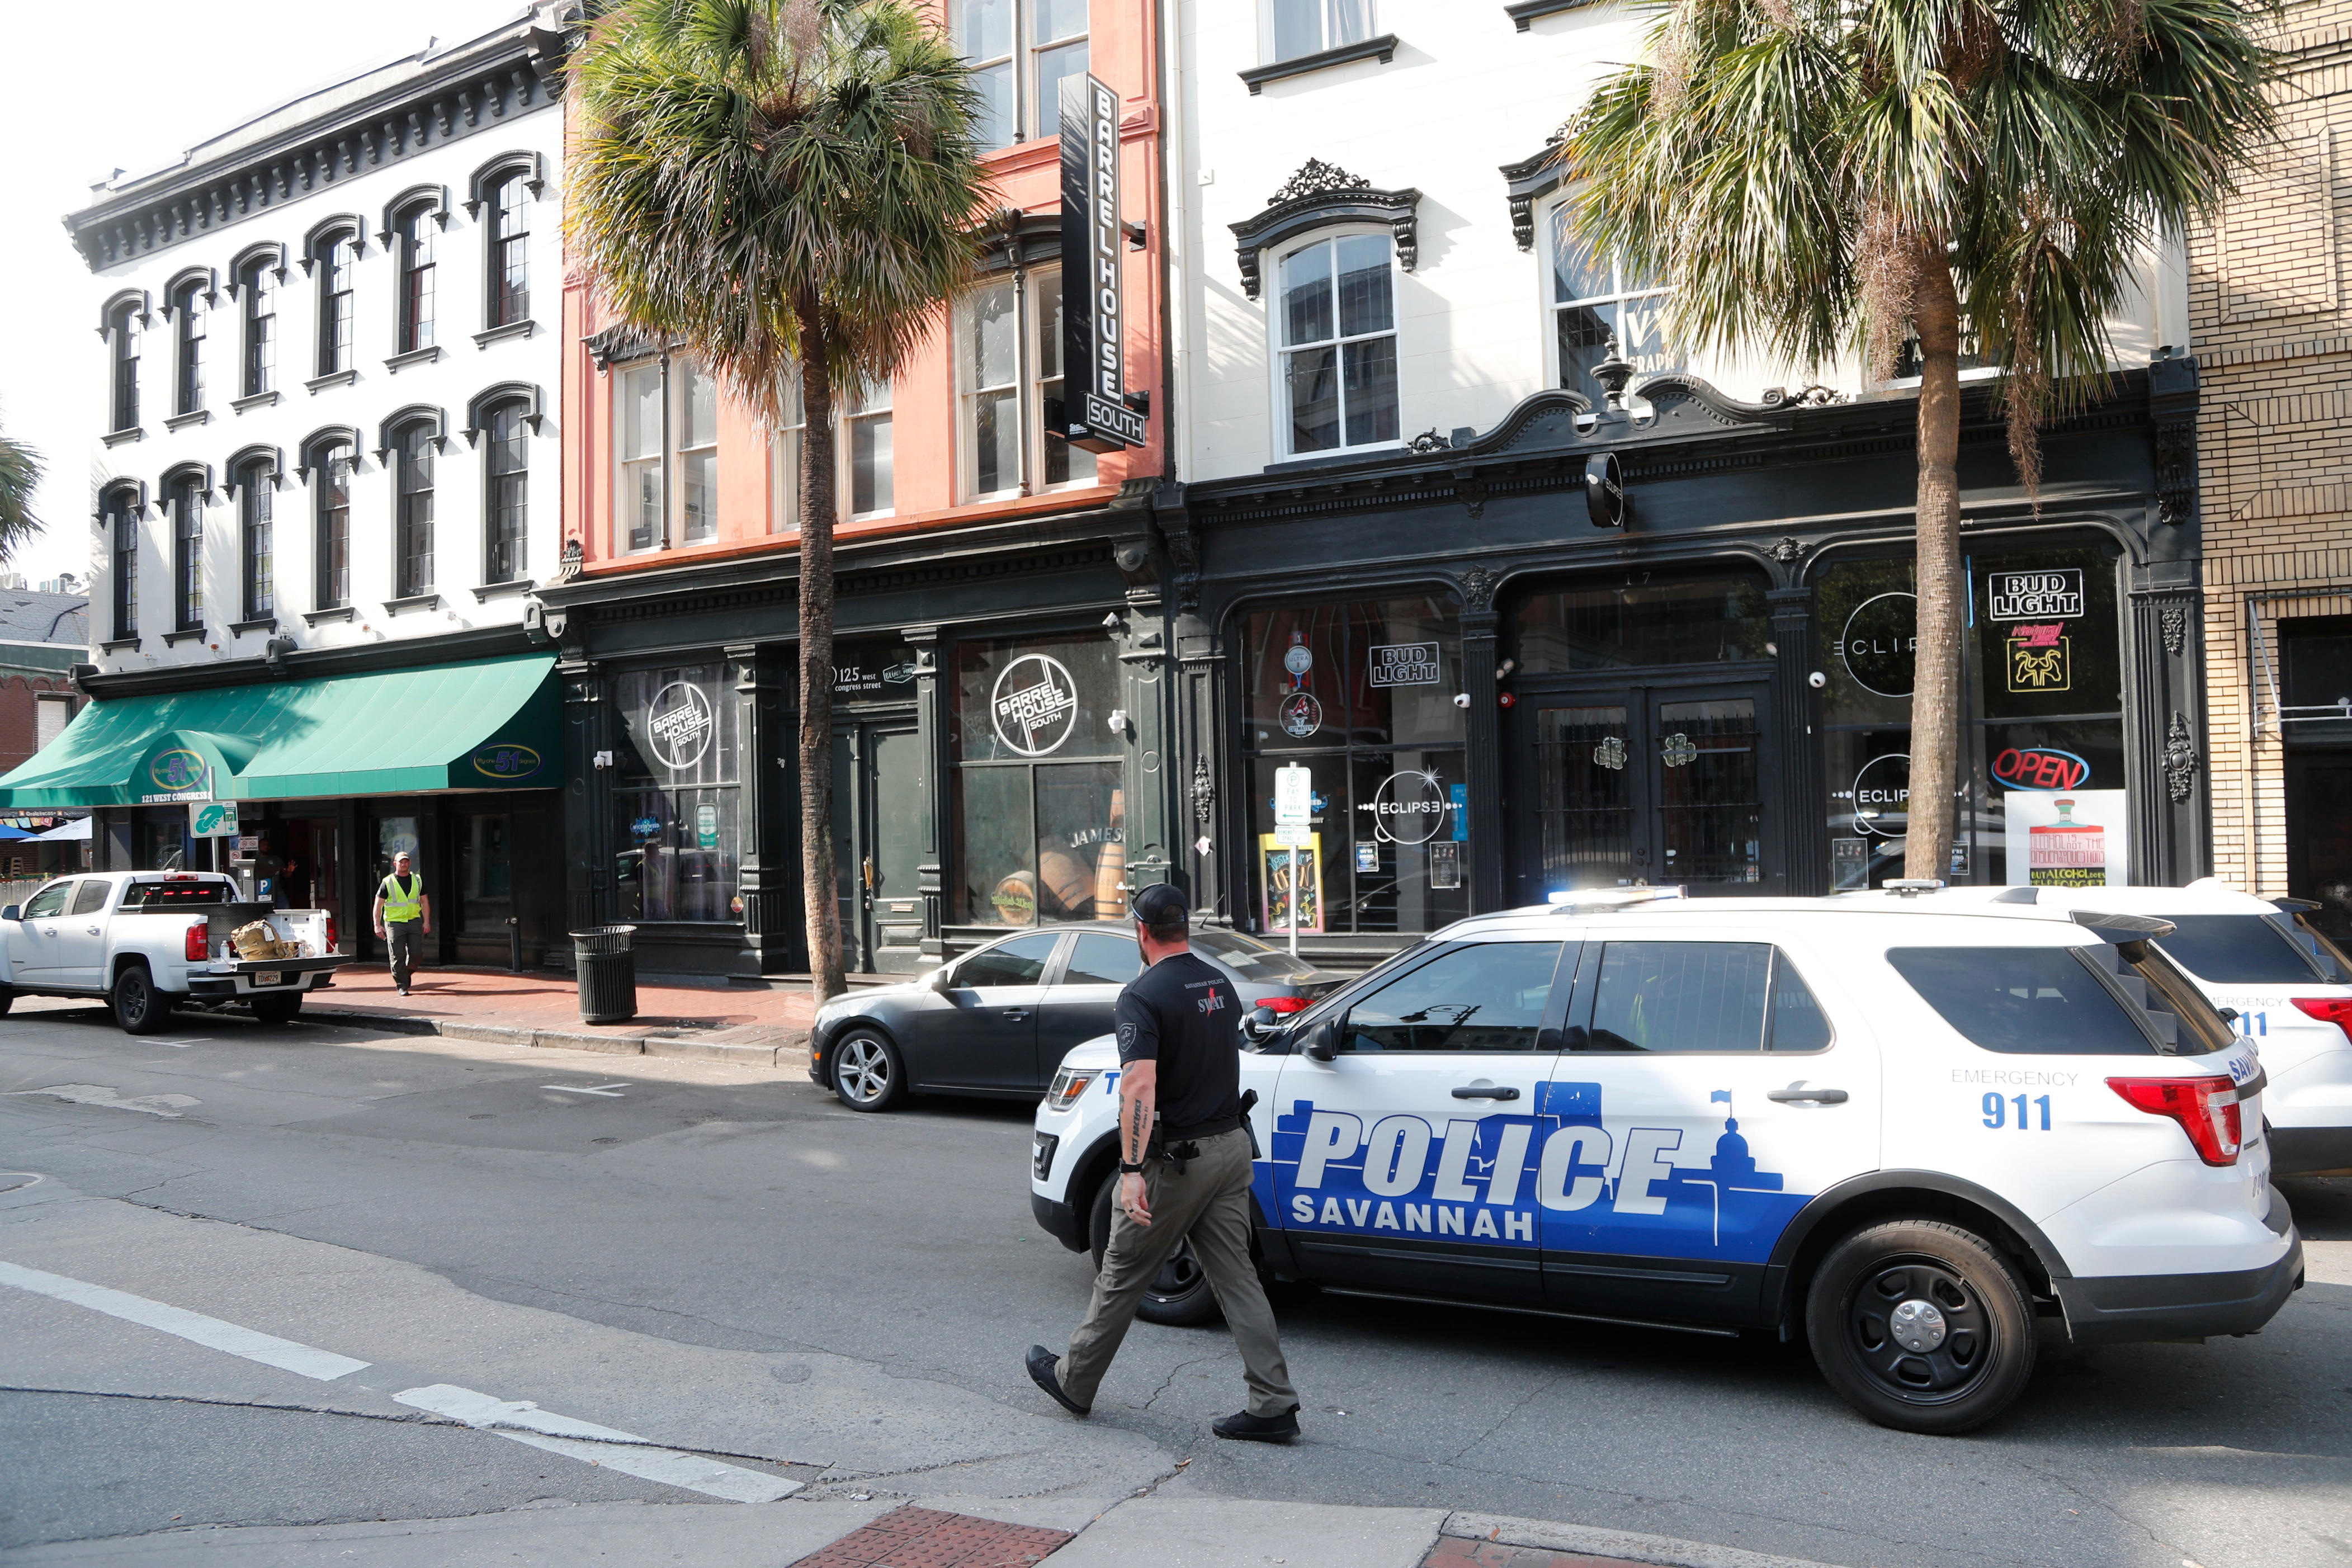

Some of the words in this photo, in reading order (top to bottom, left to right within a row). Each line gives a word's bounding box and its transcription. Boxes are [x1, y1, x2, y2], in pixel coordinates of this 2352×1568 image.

[1090, 401, 1142, 440] SOUTH
[2005, 574, 2066, 596] BUD
[1994, 593, 2079, 616] LIGHT
[2011, 622, 2064, 636] Natural
[1382, 646, 1427, 665] BUD
[840, 667, 859, 682] 125
[1374, 663, 1436, 683] LIGHT
[835, 684, 861, 692] congress
[999, 683, 1062, 716] BARREL
[1011, 692, 1065, 723] HOUSE
[653, 706, 701, 734] BARREL
[663, 712, 703, 742] HOUSE
[1029, 711, 1062, 730] SOUTH
[677, 729, 701, 747] SOUTH
[168, 758, 187, 782] 51
[495, 751, 519, 772] 51
[1994, 748, 2082, 791] OPEN
[141, 795, 153, 803] 121
[153, 794, 172, 802] WEST
[172, 791, 208, 801] CONGRESS
[1859, 789, 1910, 803] ECLIP
[1070, 826, 1126, 848] JAMES
[2085, 838, 2104, 849] THE
[1273, 863, 1313, 891] OPN
[2030, 871, 2047, 879] BUT
[2047, 868, 2090, 879] ALCOHOL
[260, 880, 268, 892] P
[1184, 981, 1208, 989] SAVANNAH
[1198, 995, 1225, 1013] SWAT
[2211, 996, 2284, 1007] ERGENCY
[2230, 1011, 2267, 1036] 11
[1104, 1072, 1121, 1095] T
[1952, 1069, 2079, 1087] EMERGENCY
[1982, 1092, 2051, 1131] 911
[1295, 1110, 1683, 1216] POLICE
[1292, 1194, 1533, 1241] SAVANNAH
